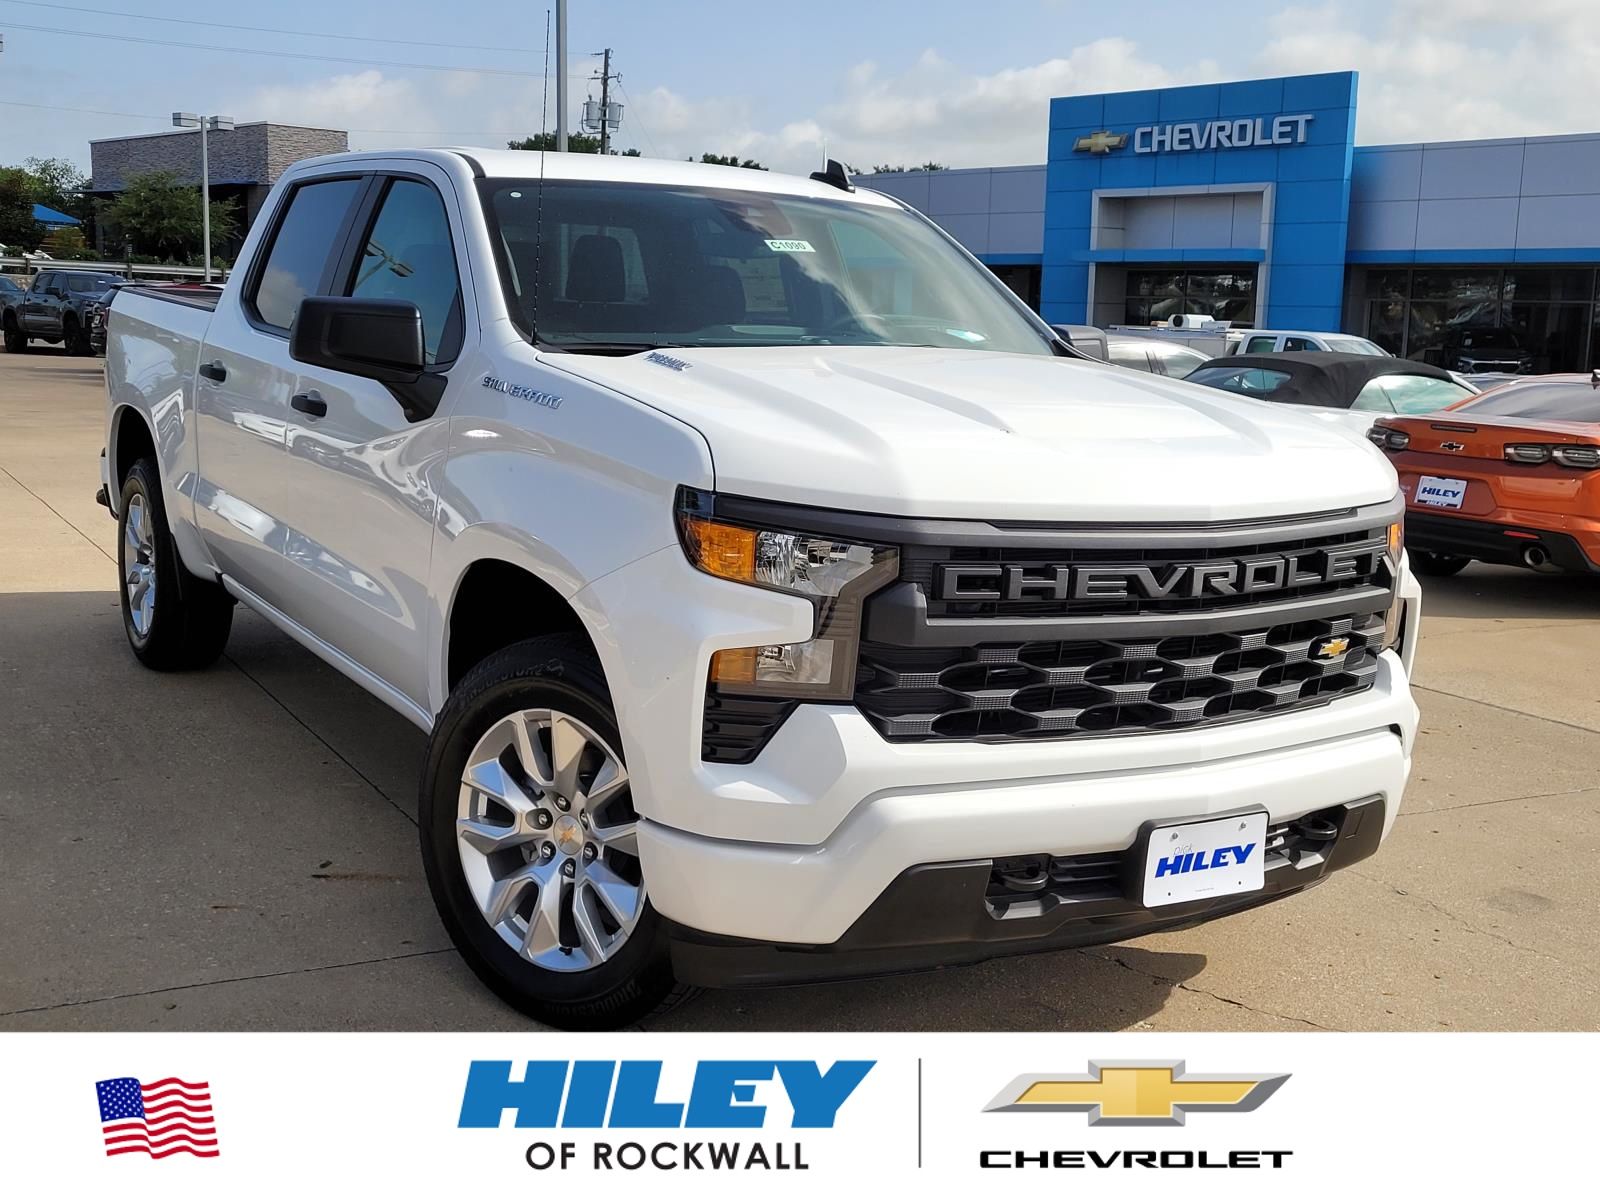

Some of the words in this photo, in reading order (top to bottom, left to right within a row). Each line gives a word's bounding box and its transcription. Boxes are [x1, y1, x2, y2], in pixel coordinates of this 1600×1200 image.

[1134, 114, 1313, 153] CHEVROLET
[482, 376, 563, 410] SILVERADO
[1421, 486, 1461, 498] HILEY
[938, 541, 1388, 601] CHEVROLET
[1154, 842, 1257, 878] HILEY
